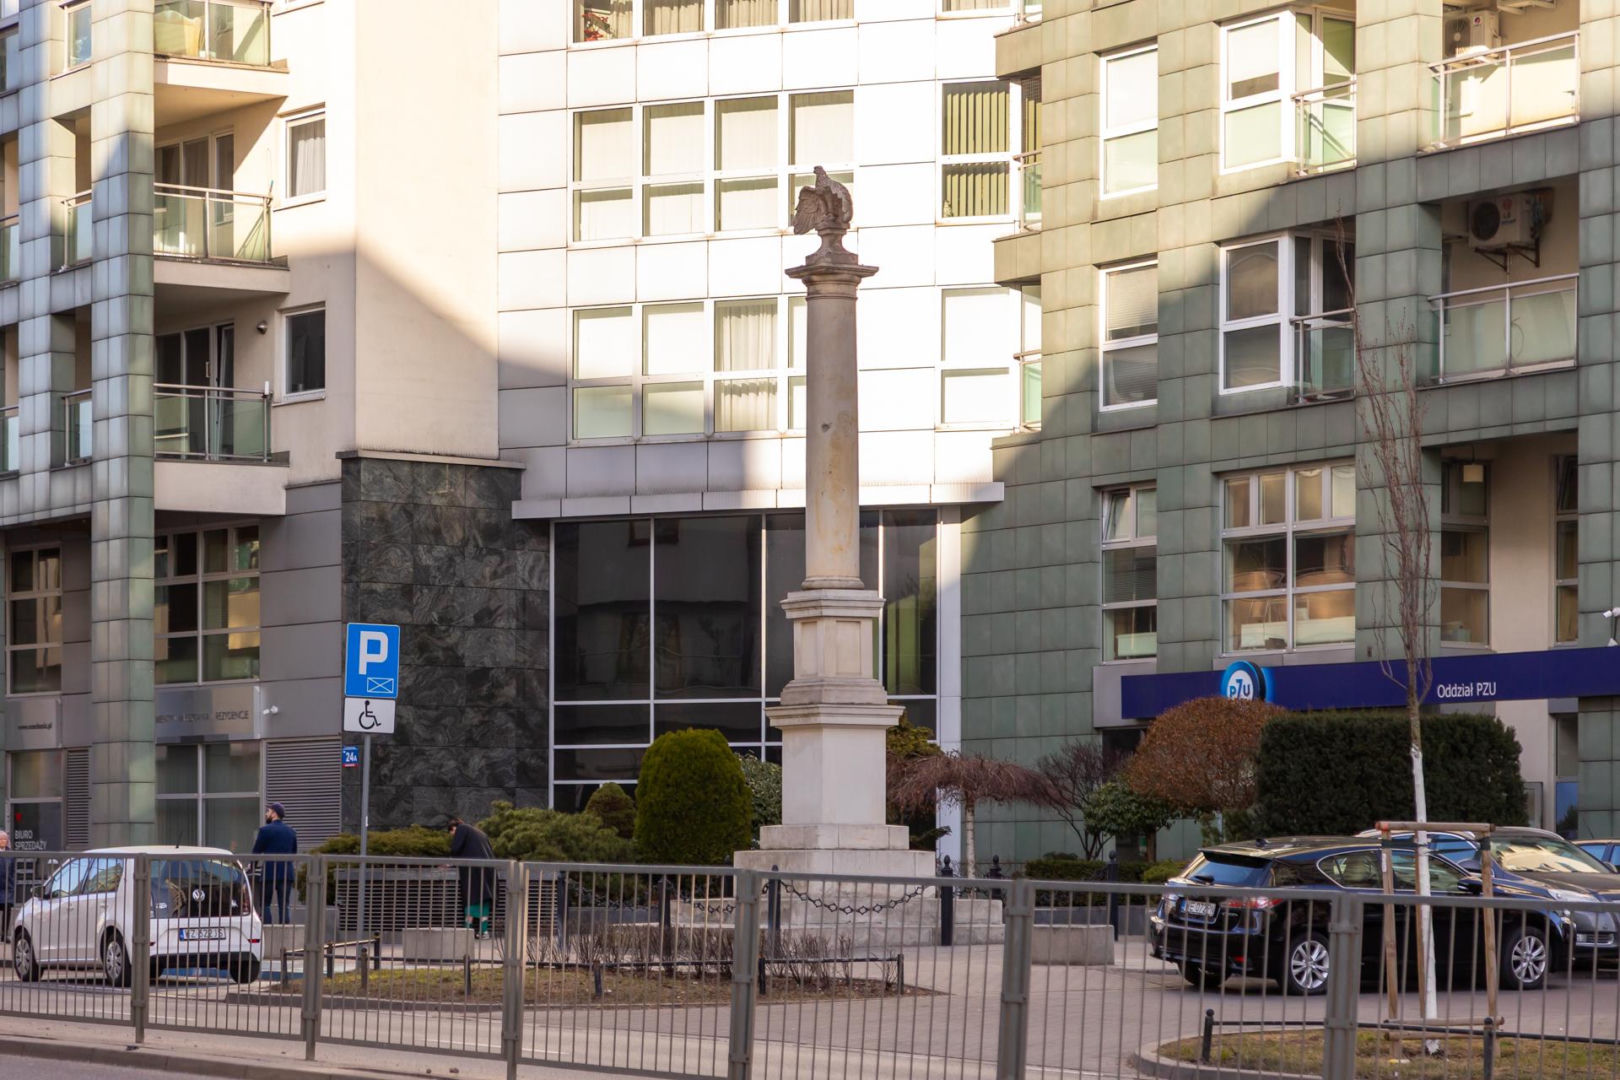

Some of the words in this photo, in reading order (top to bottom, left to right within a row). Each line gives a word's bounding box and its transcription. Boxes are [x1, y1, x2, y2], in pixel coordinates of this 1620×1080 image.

[359, 631, 388, 675] P
[1437, 682, 1474, 698] Oddział
[1476, 681, 1497, 697] PZU
[15, 829, 33, 840] BIURO
